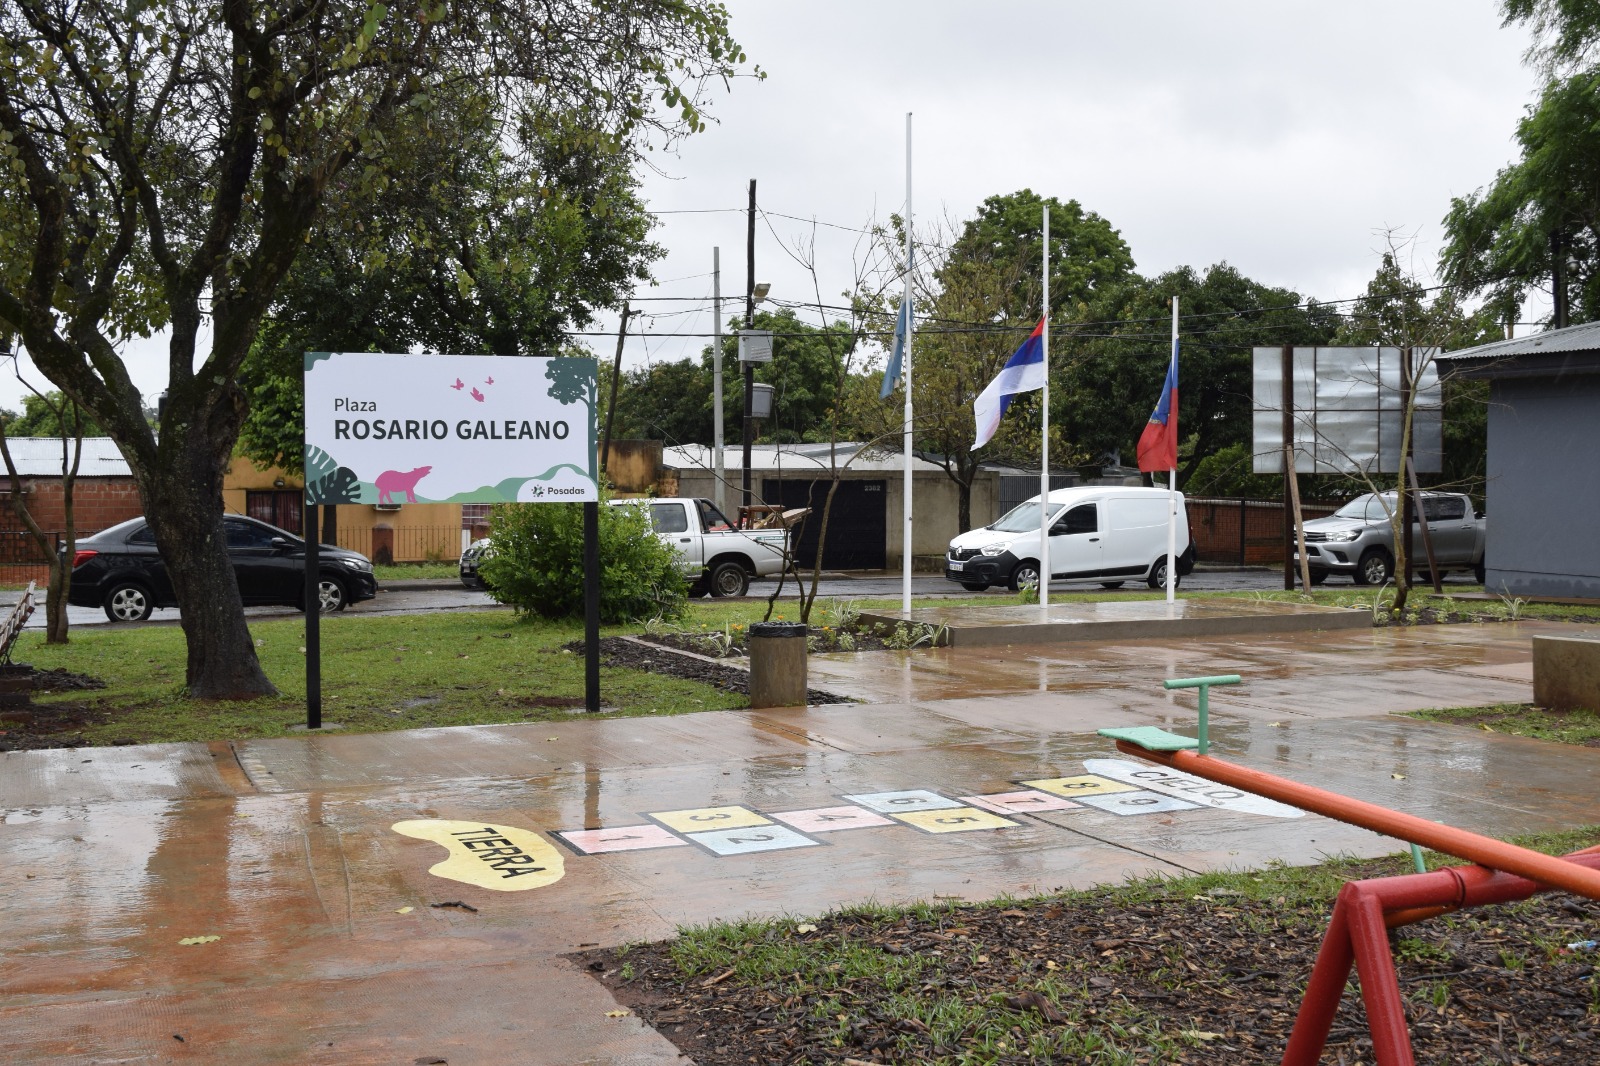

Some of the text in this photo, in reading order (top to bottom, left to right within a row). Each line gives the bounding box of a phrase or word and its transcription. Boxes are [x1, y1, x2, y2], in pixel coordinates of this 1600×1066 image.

[334, 397, 377, 412] Plaza
[334, 419, 570, 440] ROSARIO GALEANO
[547, 486, 585, 495] Posadas
[1130, 771, 1245, 799] CIELO
[887, 797, 928, 805] 6
[1118, 798, 1159, 806] 9
[689, 813, 732, 822] 3
[814, 813, 857, 823] 4
[935, 816, 980, 824] 5
[598, 834, 643, 843] 1
[727, 834, 775, 845] 2
[450, 827, 547, 879] TIERRA
